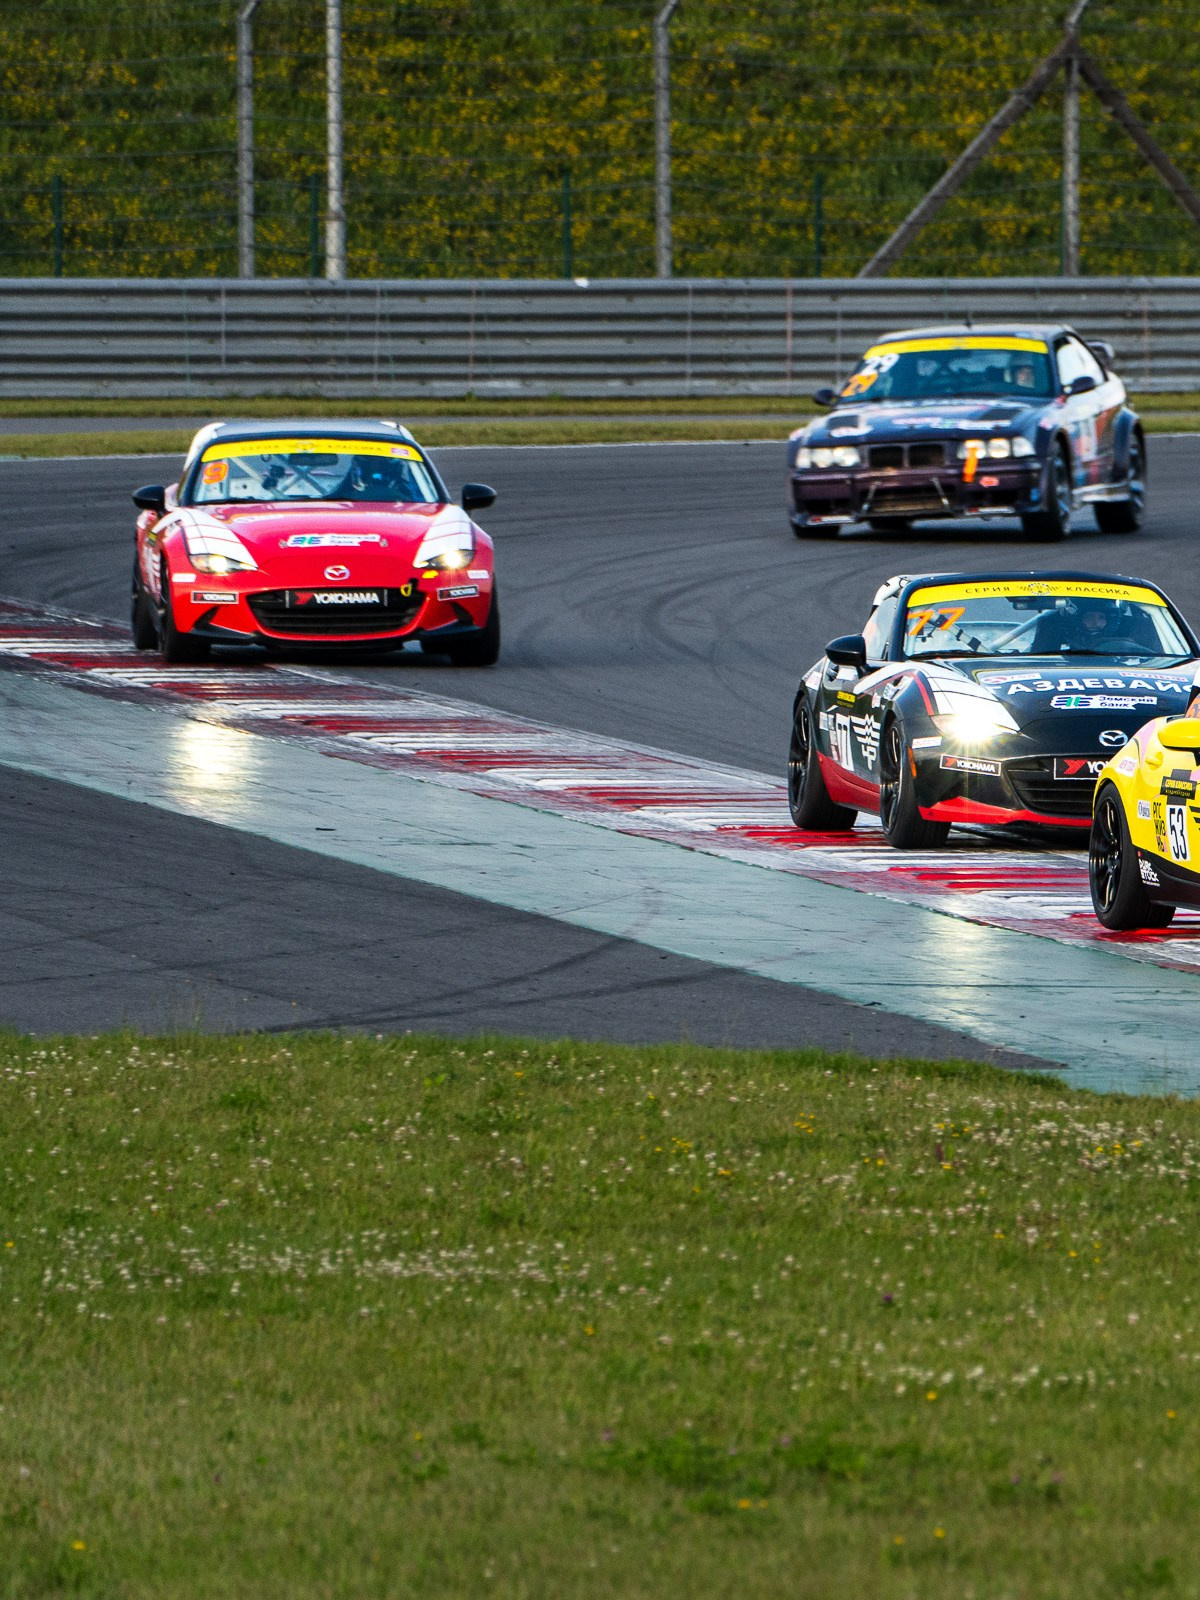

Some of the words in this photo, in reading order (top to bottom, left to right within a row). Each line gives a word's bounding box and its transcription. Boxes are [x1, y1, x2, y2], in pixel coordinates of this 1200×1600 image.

[203, 461, 229, 485] 9
[314, 592, 379, 604] YOKOHAMA
[965, 586, 1011, 594] СЕРИЯ
[1065, 586, 1131, 596] КЛАССИКА
[907, 607, 965, 636] 77
[956, 760, 995, 773] YOKOHAMA
[1169, 808, 1187, 860] 53
